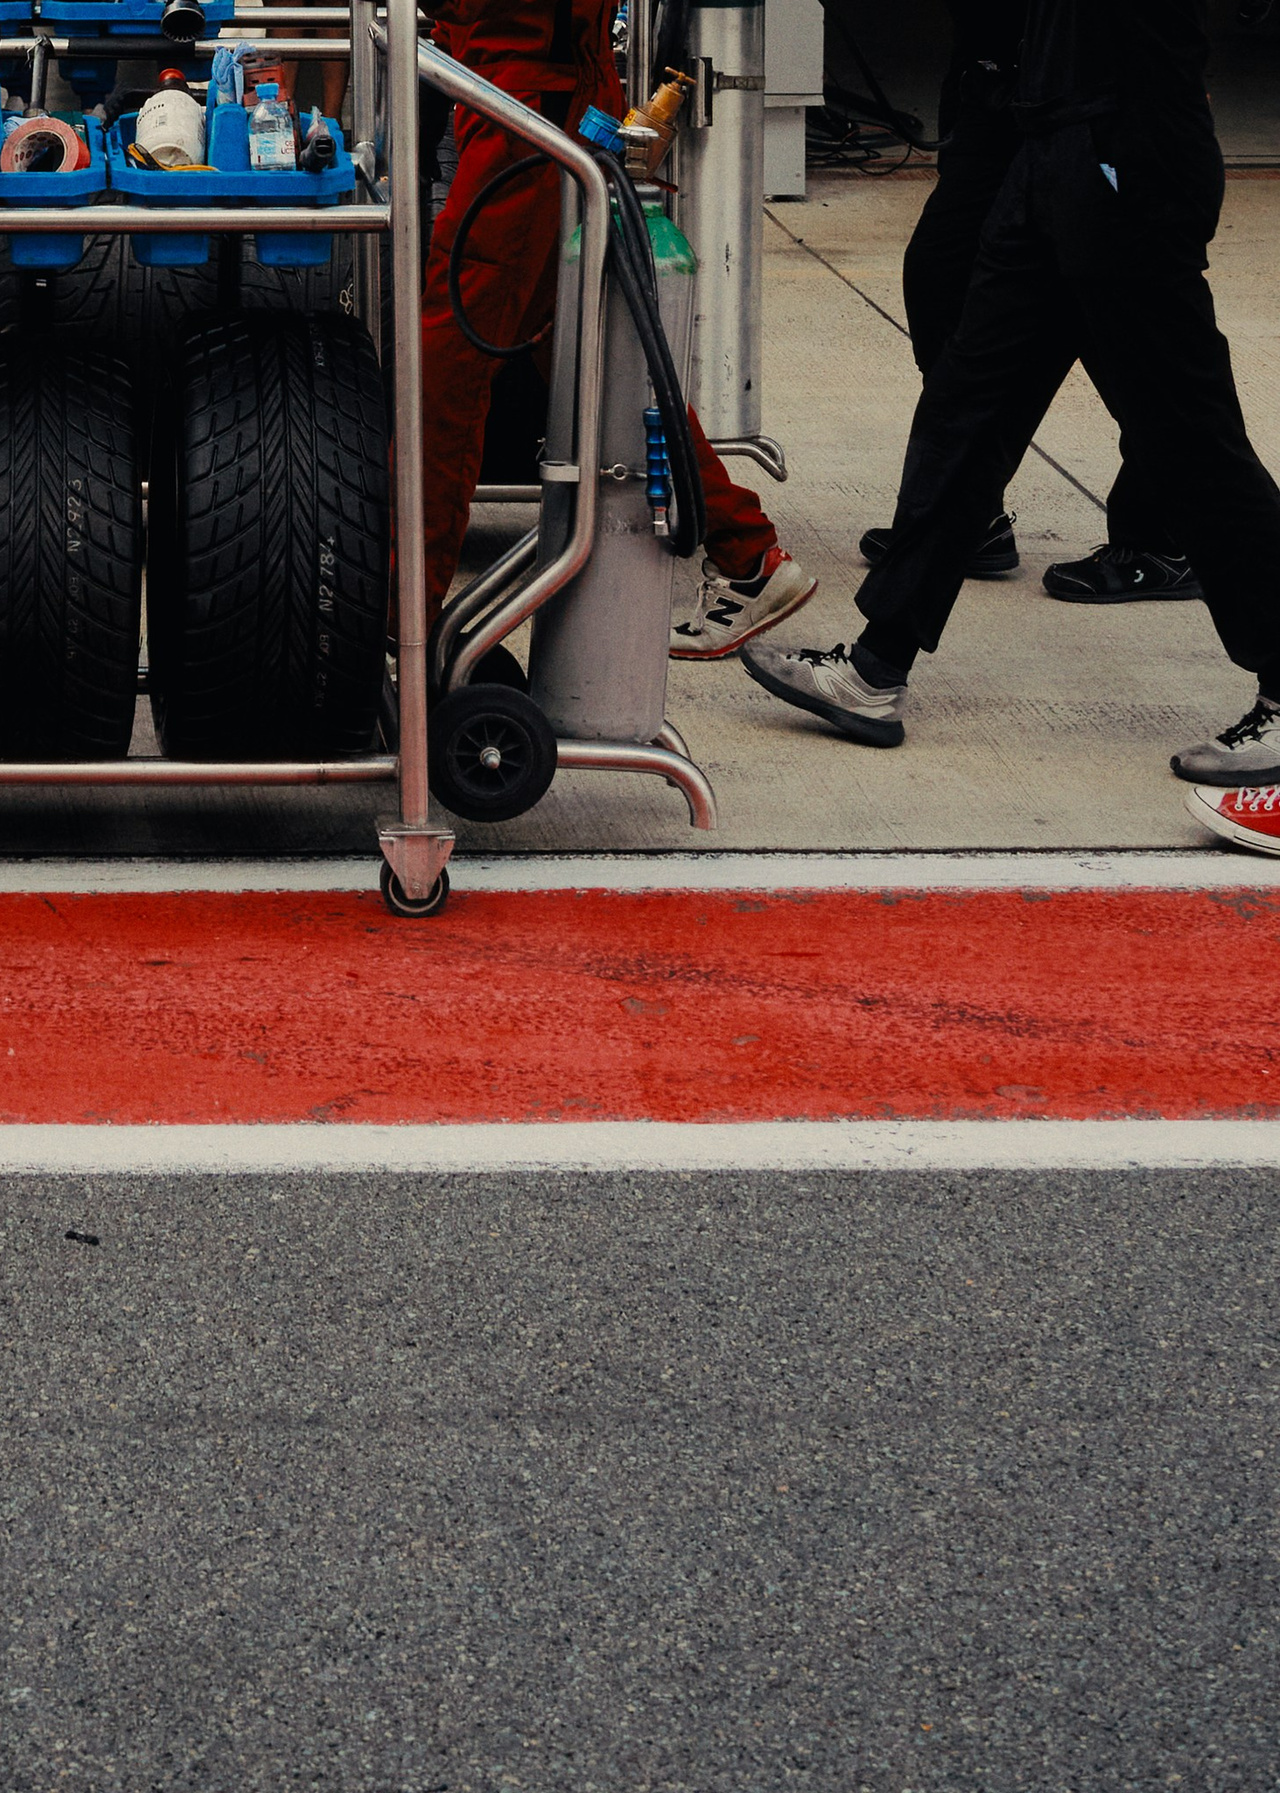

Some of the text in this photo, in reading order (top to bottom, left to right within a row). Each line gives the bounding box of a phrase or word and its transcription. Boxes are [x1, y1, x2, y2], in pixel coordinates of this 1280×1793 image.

[66, 478, 82, 553] N2923
[318, 535, 335, 612] N2784
[705, 595, 746, 628] N
